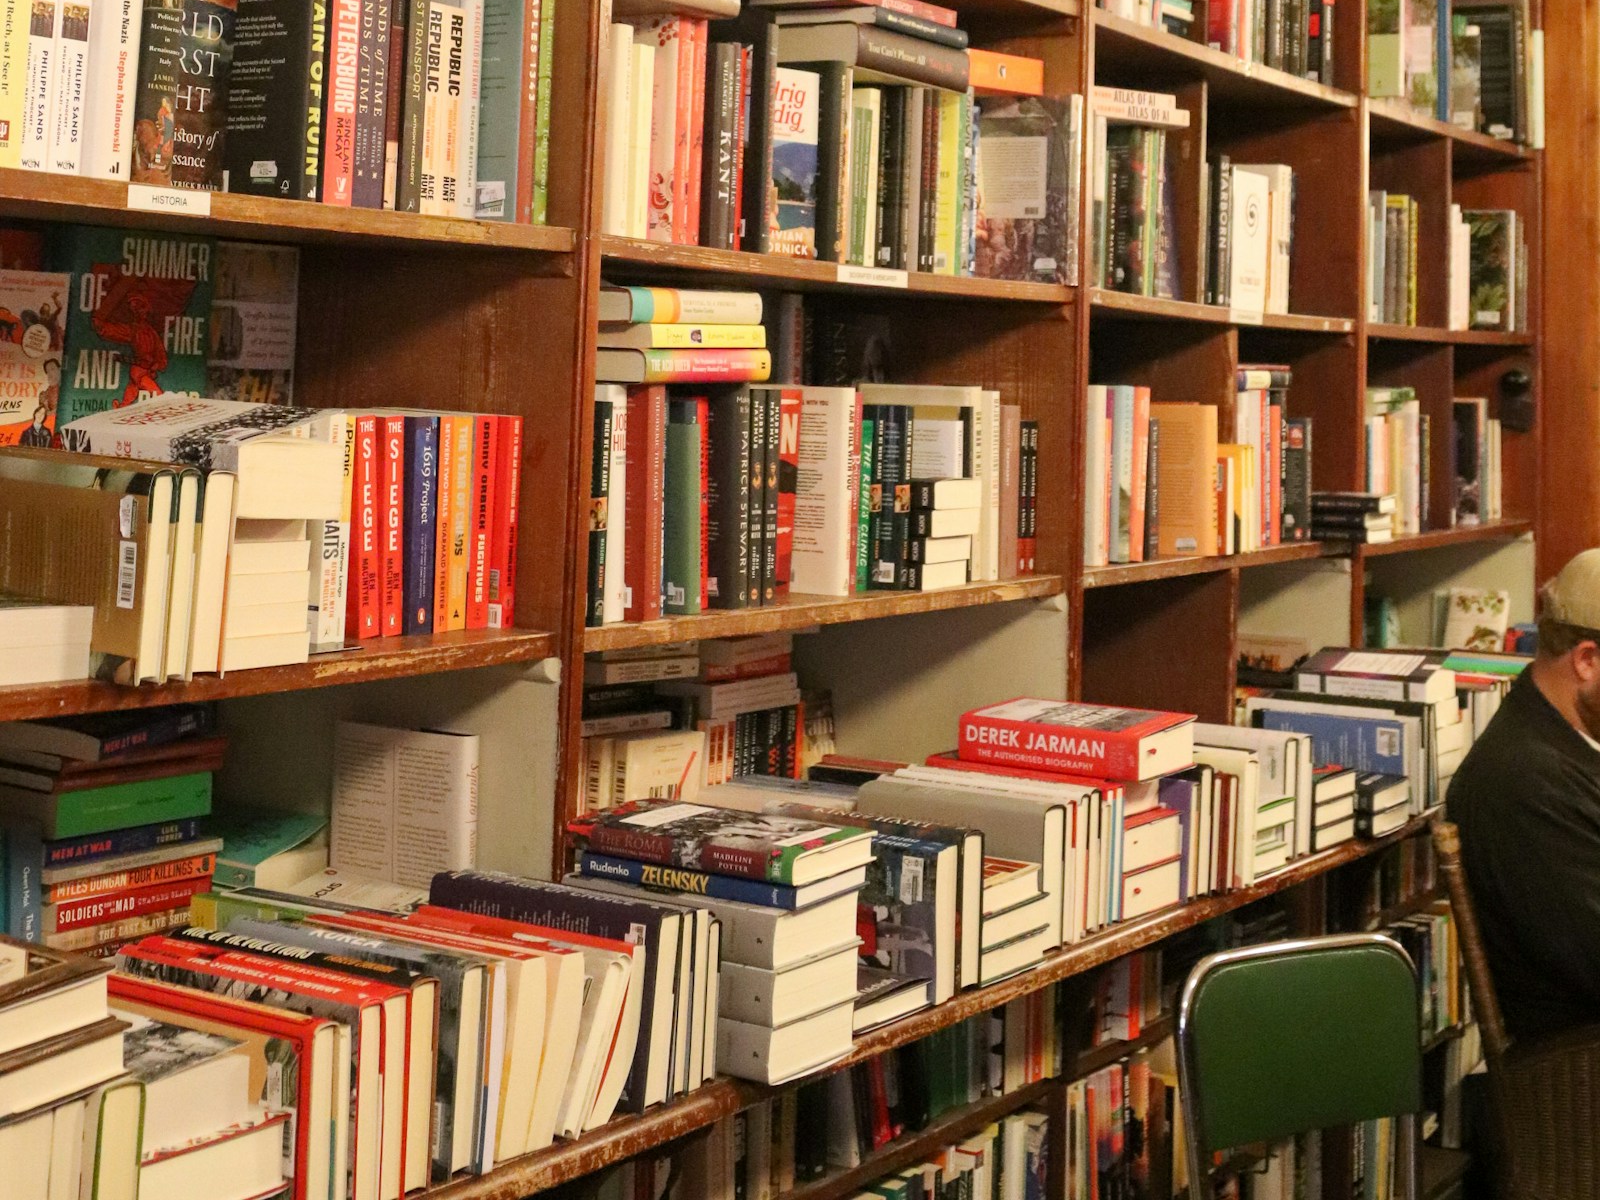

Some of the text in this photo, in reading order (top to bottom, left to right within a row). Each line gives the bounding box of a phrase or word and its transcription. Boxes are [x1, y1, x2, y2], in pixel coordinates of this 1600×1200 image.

[120, 16, 129, 44] Nazis
[118, 51, 127, 91] Stephan
[334, 5, 359, 113] PETERSBURG
[360, 44, 369, 61] of
[373, 48, 383, 64] of
[412, 23, 424, 101] TRANSPORT
[427, 9, 443, 94] REPUBLIC
[448, 14, 464, 97] REPUBLIC
[36, 50, 48, 141] PHILIPPE SANDS
[70, 54, 83, 143] PHILIPPE SANDS
[310, 60, 324, 101] OF
[358, 64, 371, 115] TIME
[373, 68, 384, 118] TIME
[528, 63, 537, 102] 1343
[1113, 89, 1156, 106] ATLAS OF AI
[112, 93, 124, 153] Malinowski
[1127, 105, 1170, 121] ATLAS OF AI
[305, 106, 322, 177] RUIN
[342, 118, 351, 174] SINCLAIR
[420, 173, 428, 201] HUNT
[718, 131, 732, 205] KANT
[151, 195, 188, 207] HISTORIA
[1218, 161, 1230, 250] STARBORN
[121, 237, 210, 282] SUMMER
[79, 272, 109, 313] OF
[163, 315, 205, 355] FIRE
[73, 350, 122, 391] AND
[460, 425, 469, 451] THE
[421, 446, 433, 476] 1619
[360, 420, 374, 552] THE SIEGE
[388, 421, 403, 552] THE SIEGE
[421, 480, 431, 525] Project
[739, 431, 748, 575] PATRICK STEWART
[860, 441, 872, 567] THE REBEL'S CLINIC
[475, 533, 485, 603] FUGITIVES
[965, 724, 1106, 759] DEREK JARMAN
[977, 748, 1094, 772] THE AUTHORISED BIOGRAPHY
[56, 861, 194, 898] MYLES DUNGAN FOUR KILLINGS
[589, 860, 710, 895] Rudenko ZELENSKY
[713, 852, 752, 866] MADELINE
[718, 861, 749, 874] POTTER
[59, 897, 136, 925] SOLDIERS MAD
